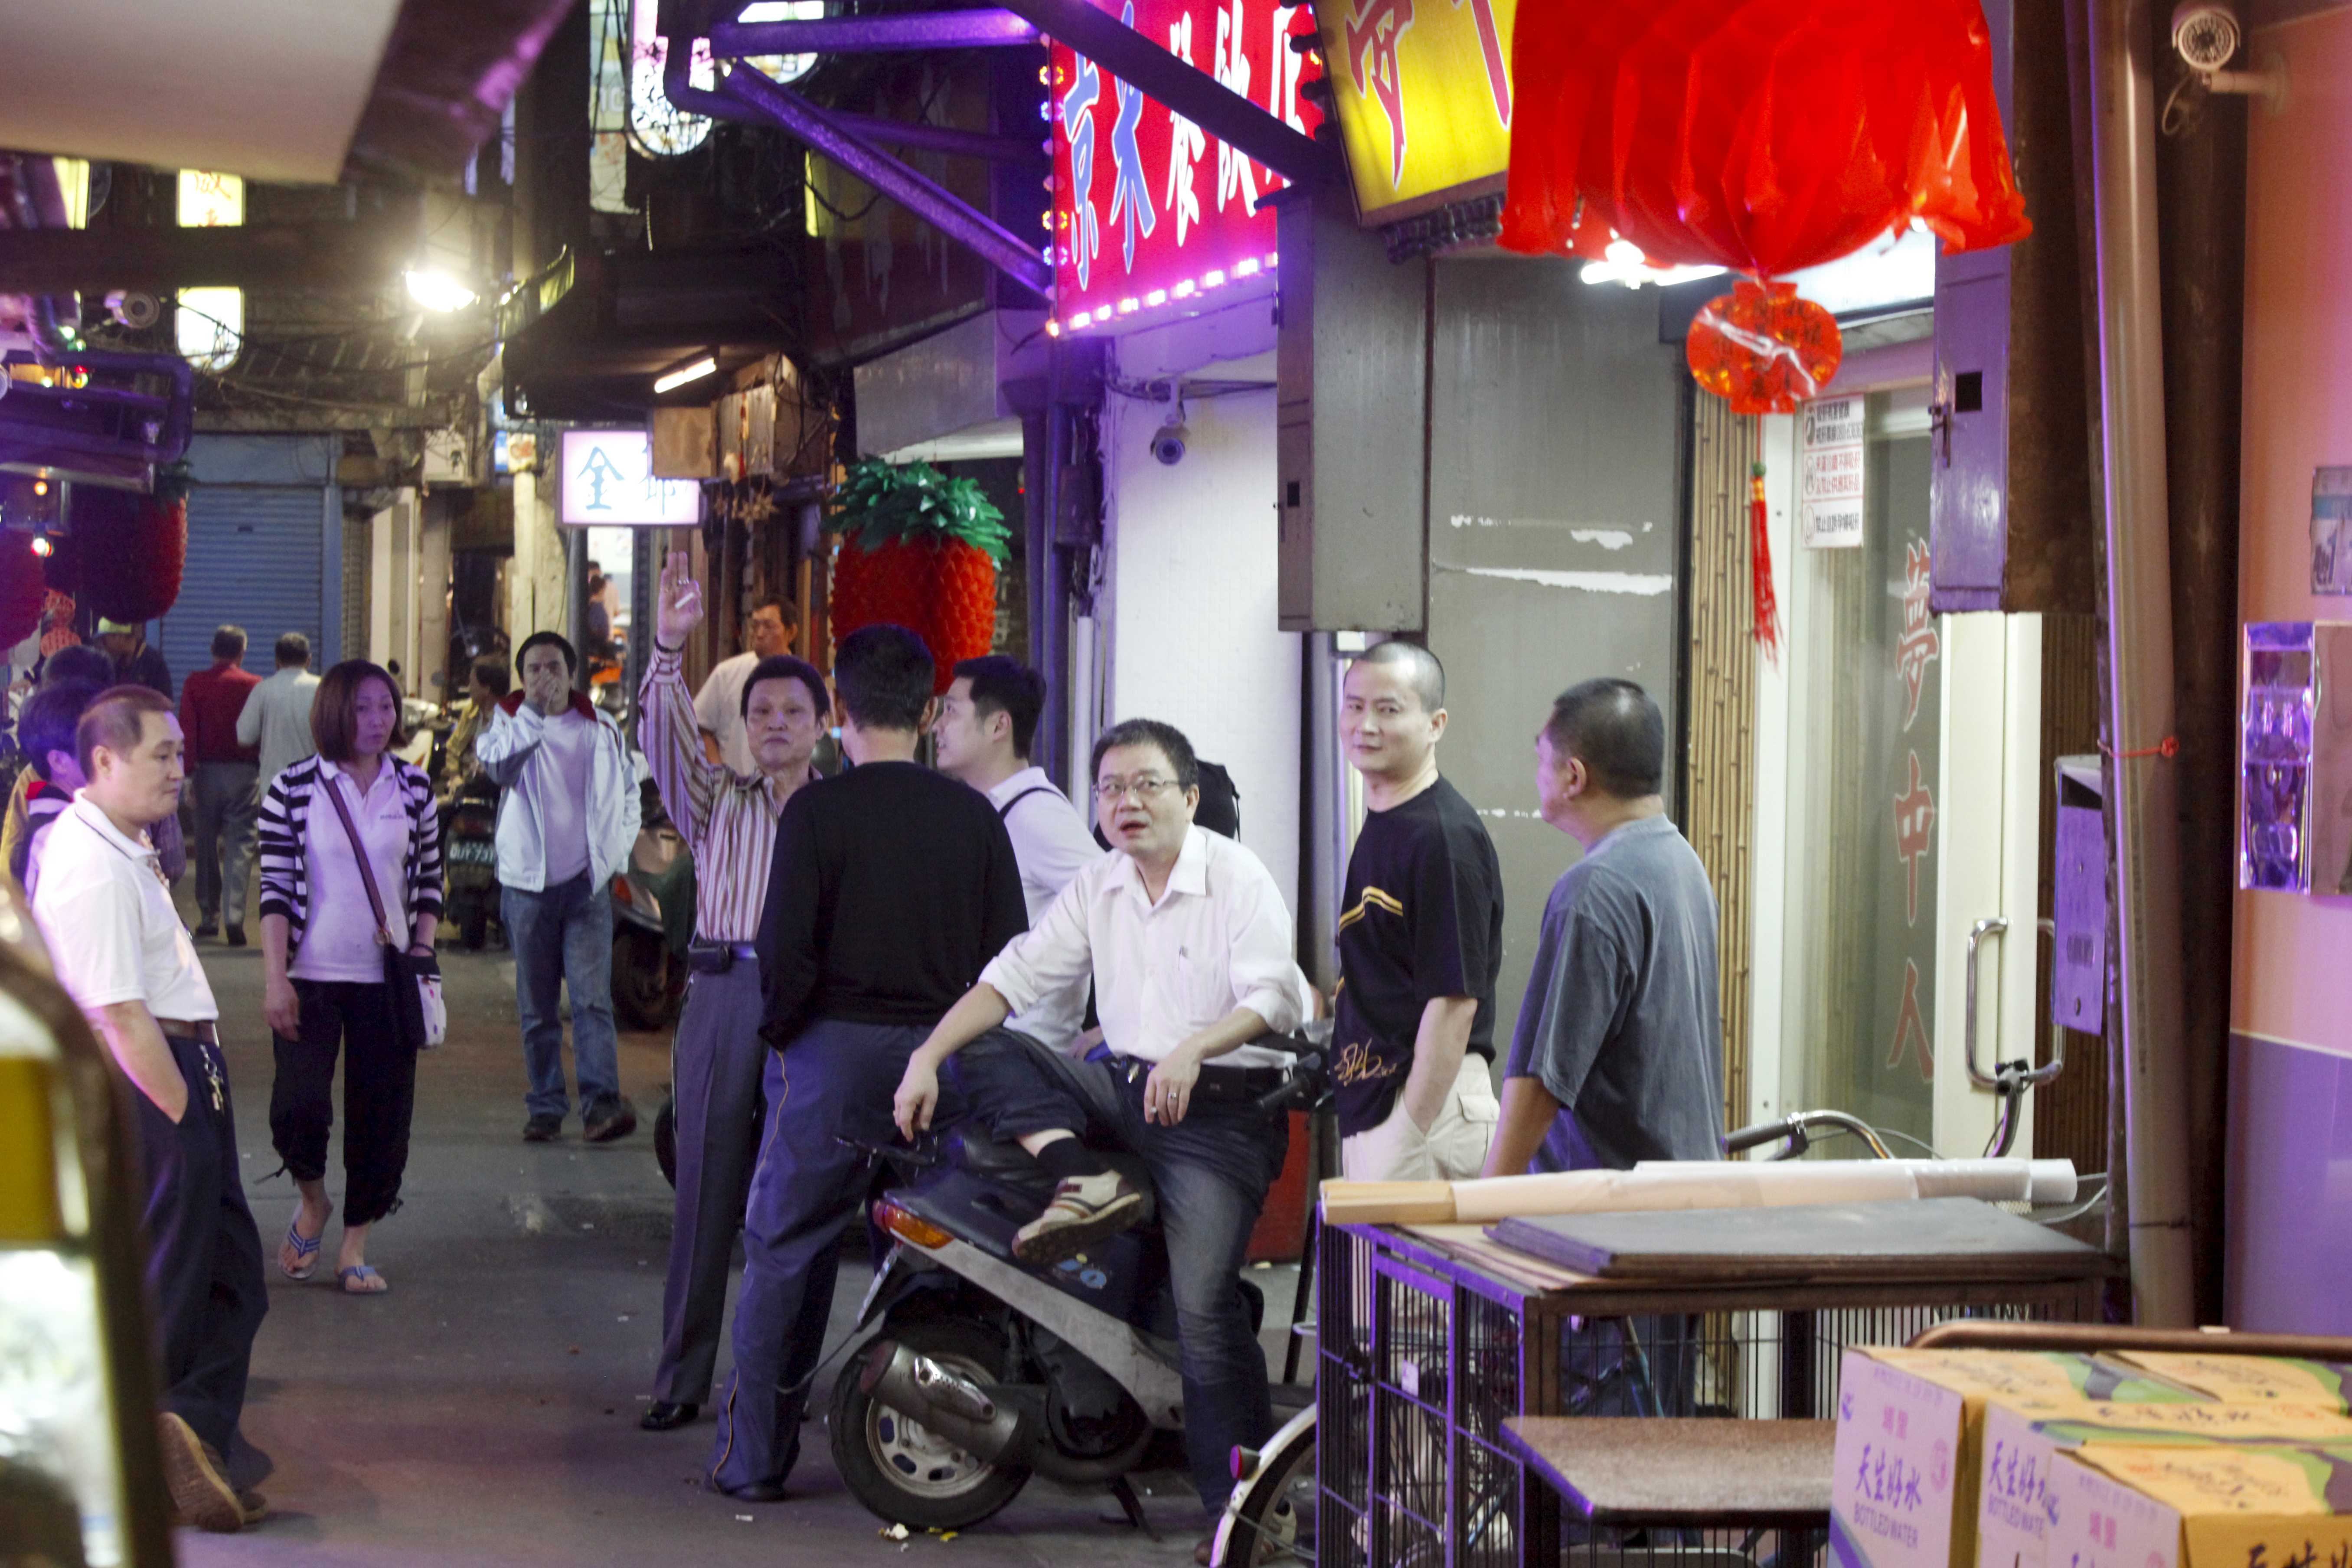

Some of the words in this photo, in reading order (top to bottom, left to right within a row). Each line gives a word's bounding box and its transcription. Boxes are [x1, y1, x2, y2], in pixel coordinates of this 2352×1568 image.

[1886, 538, 1939, 1084] 夢中人
[1854, 1501, 1889, 1538] BOTTLED
[1890, 1518, 1919, 1550] WATER
[1987, 1492, 2020, 1529] BOTTLED
